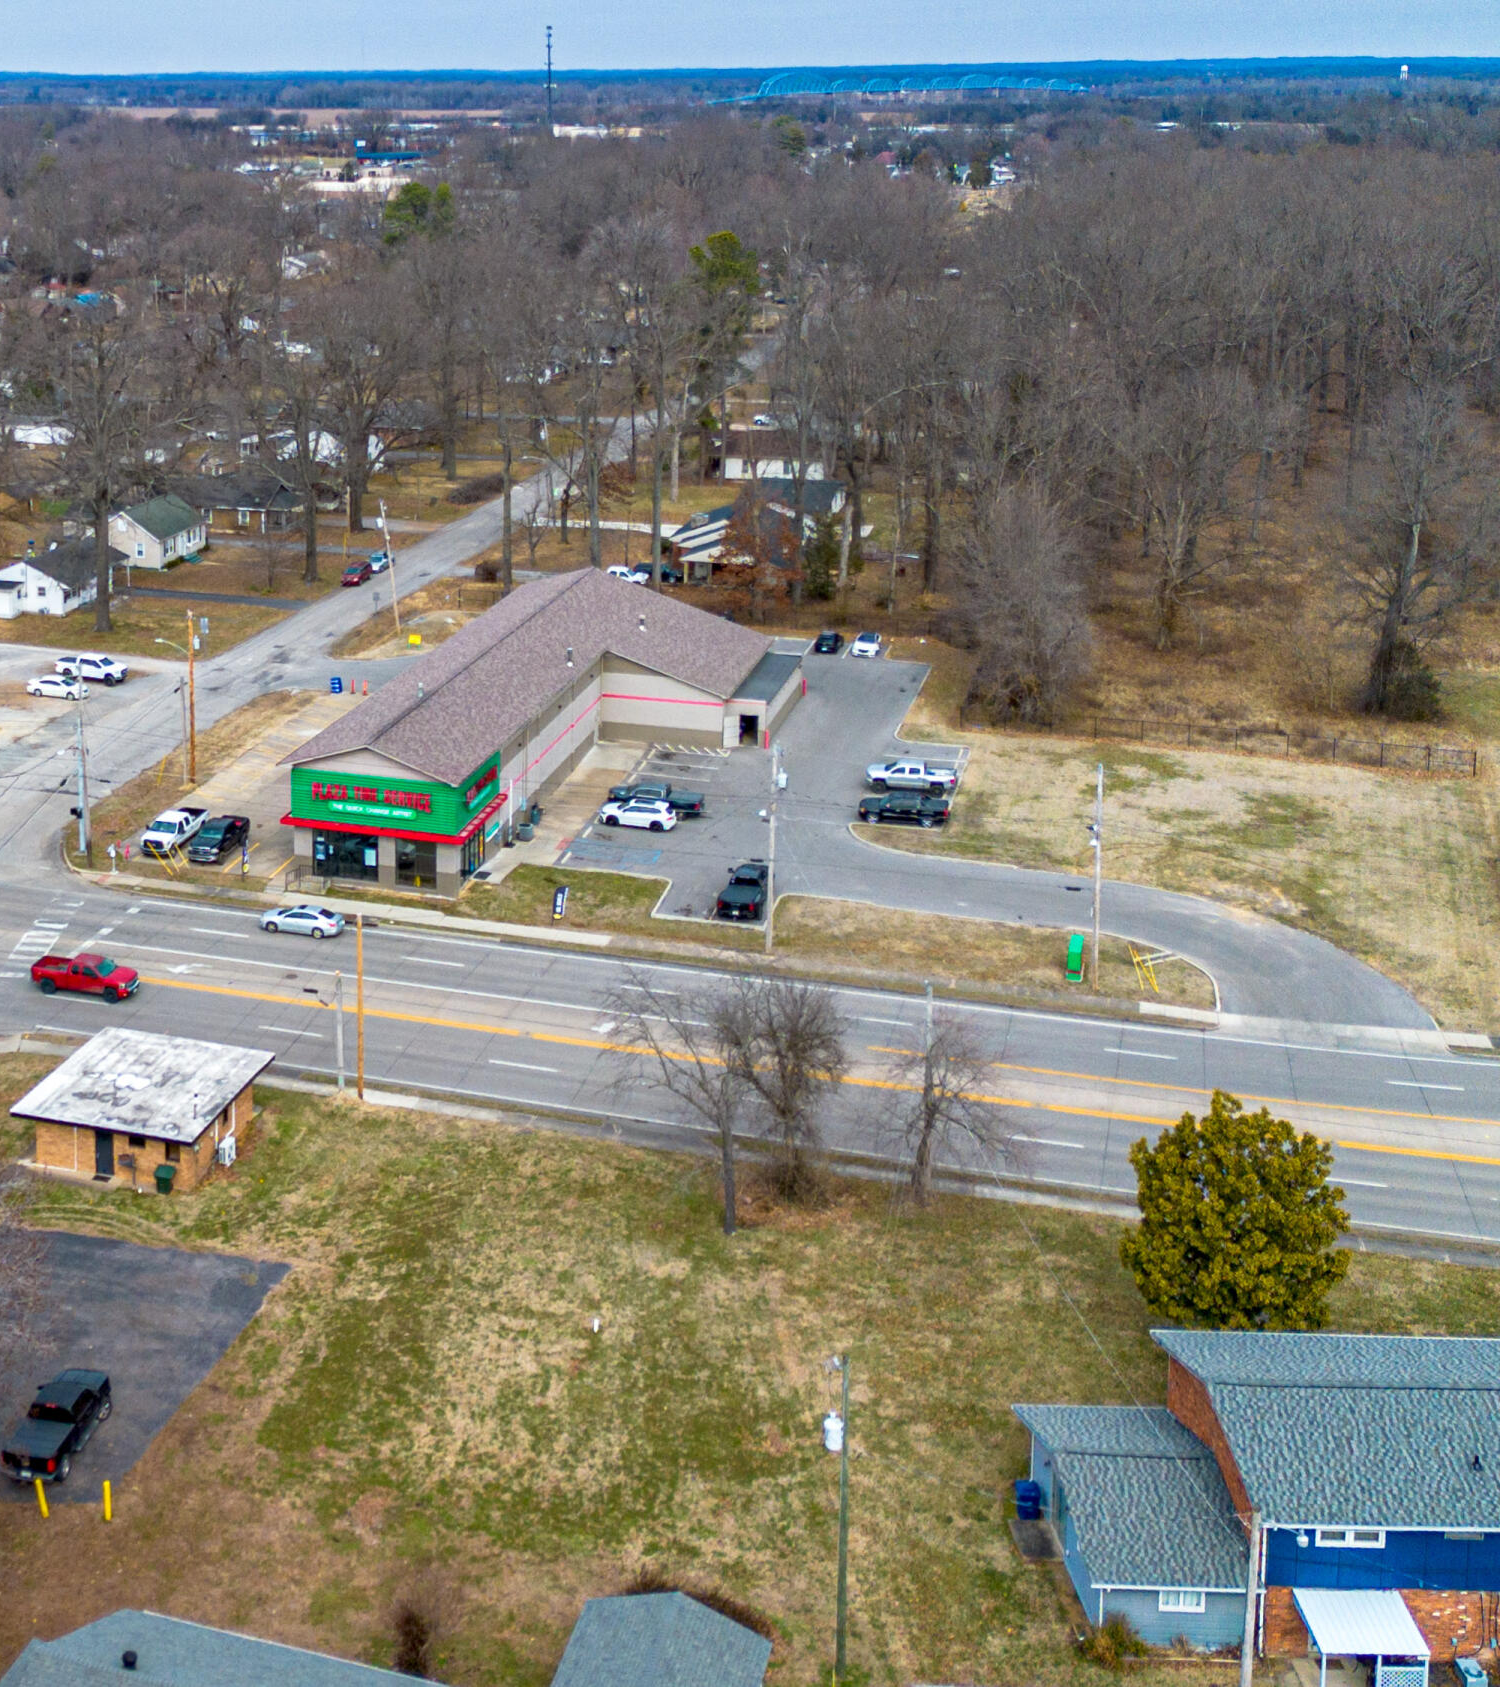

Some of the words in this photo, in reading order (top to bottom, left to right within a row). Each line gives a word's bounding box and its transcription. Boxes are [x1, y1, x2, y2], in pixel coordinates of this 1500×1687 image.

[312, 781, 348, 800] PLAZA
[353, 785, 378, 802] TIRE
[383, 788, 432, 813] SERVICE
